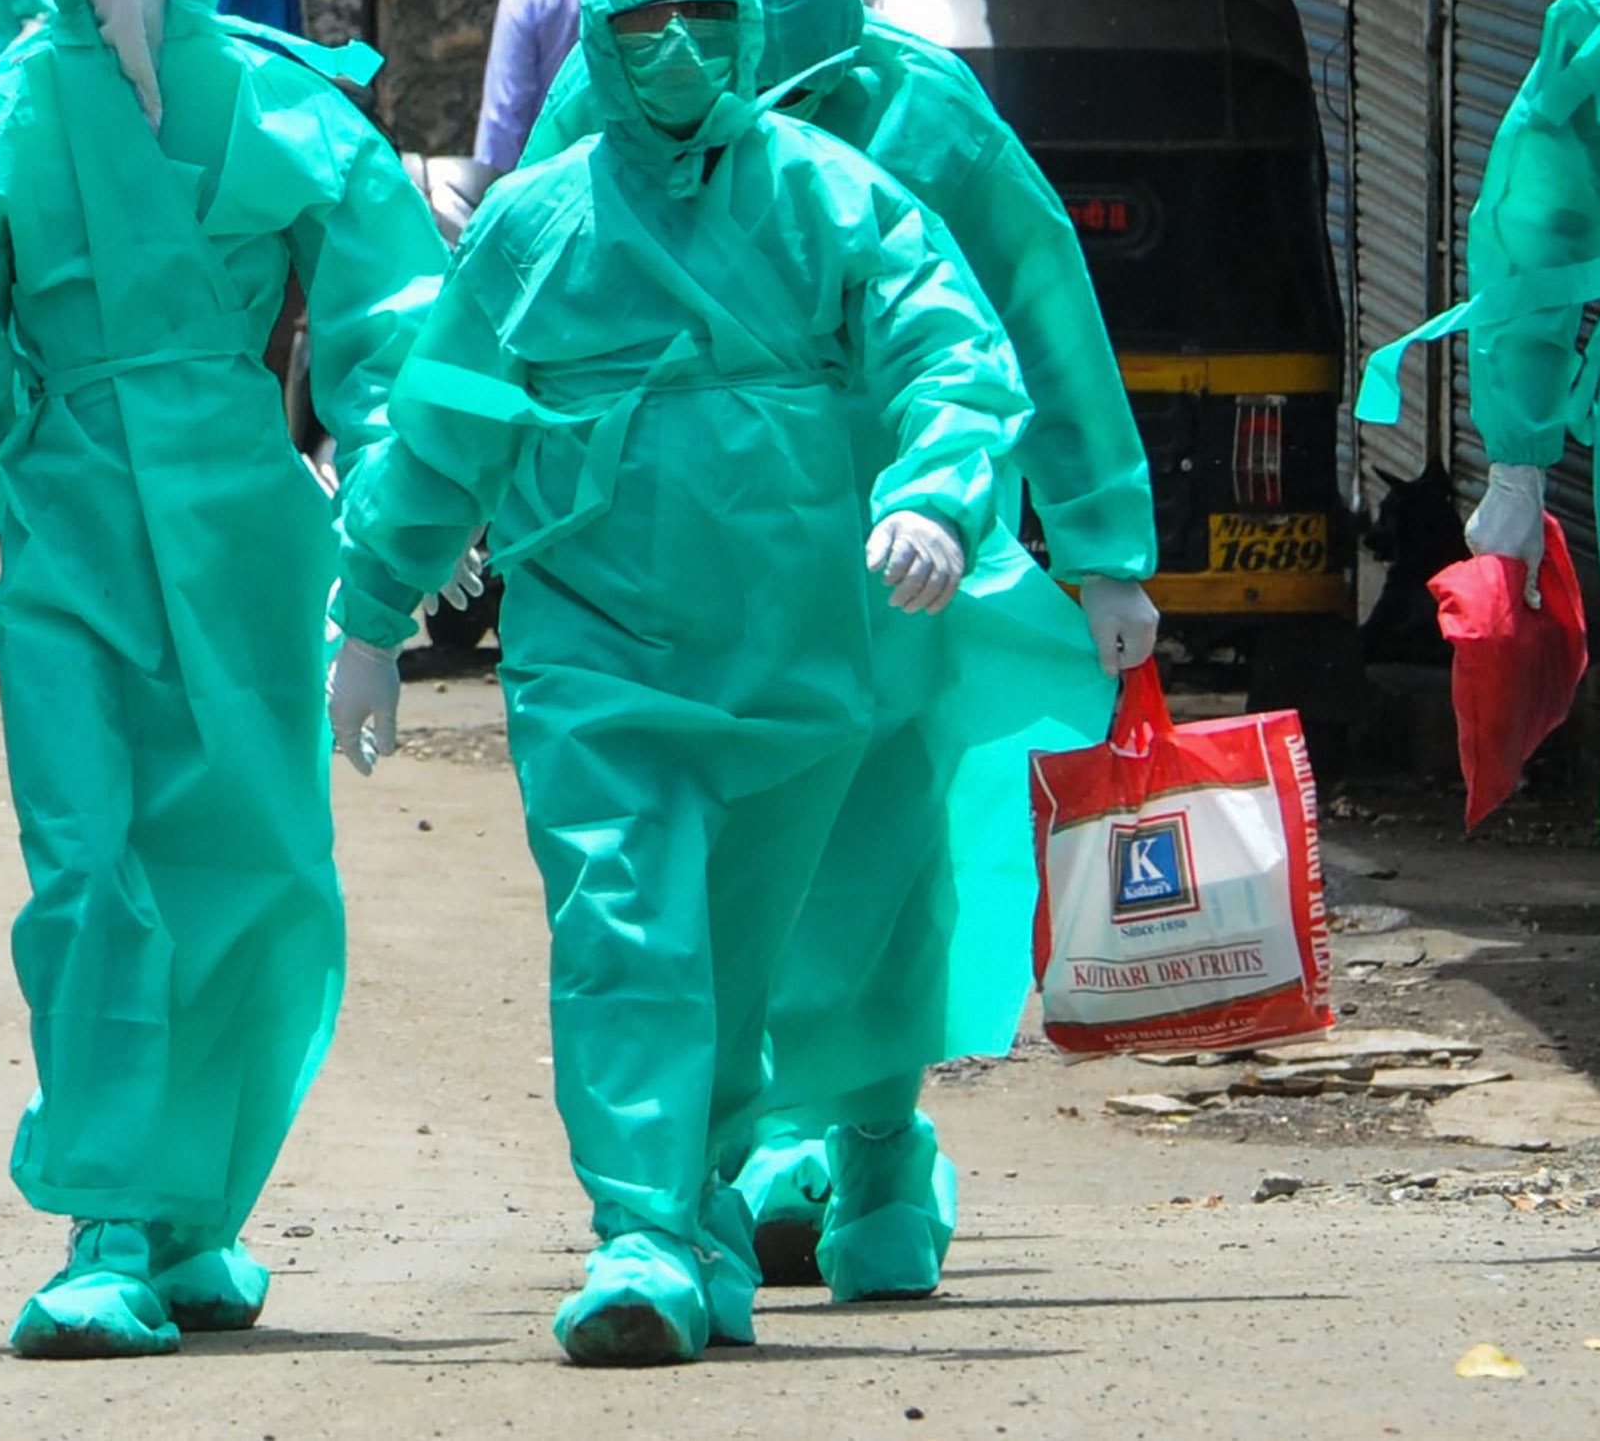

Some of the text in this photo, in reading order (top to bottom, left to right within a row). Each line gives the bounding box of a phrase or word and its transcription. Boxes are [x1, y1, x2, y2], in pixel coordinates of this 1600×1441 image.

[1214, 539, 1323, 572] 1689
[1130, 838, 1165, 881] K
[1073, 949, 1263, 988] KOTHARI DRY FRUITS
